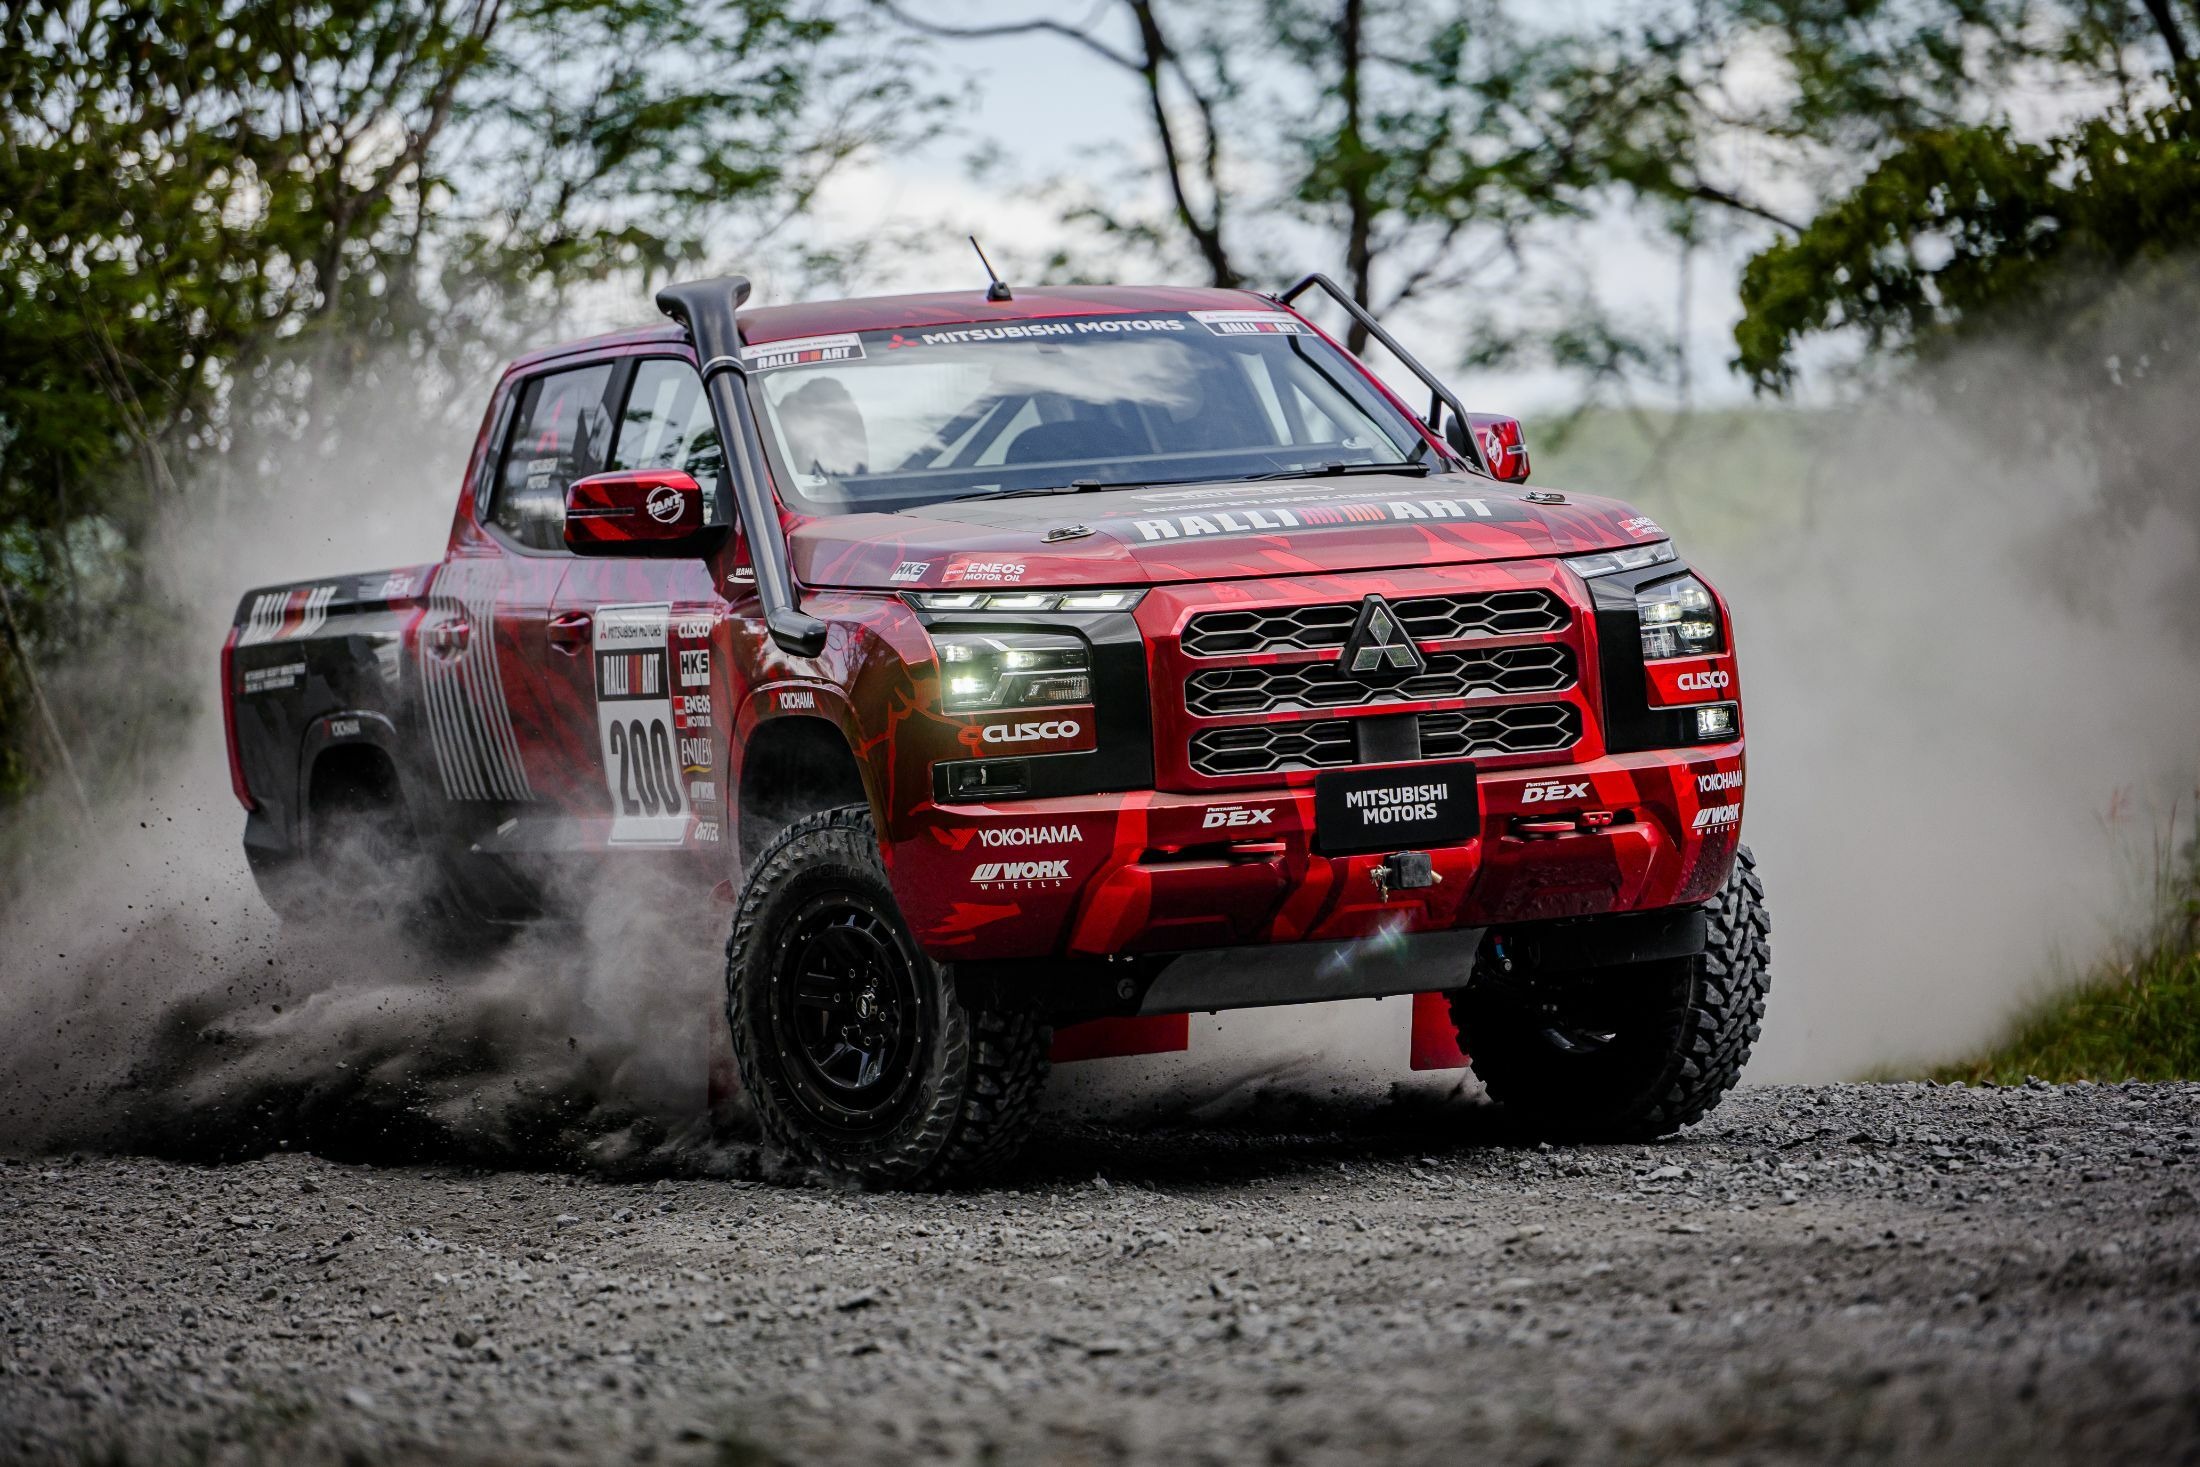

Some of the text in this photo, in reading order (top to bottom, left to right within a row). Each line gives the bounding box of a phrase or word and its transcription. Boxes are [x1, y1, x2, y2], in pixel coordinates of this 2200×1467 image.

[922, 319, 1186, 345] MITSUBISHI MOTORS
[756, 347, 851, 369] RALLI ART
[1133, 508, 1301, 541] RALLI
[1387, 499, 1493, 519] ART
[895, 561, 928, 577] HKS
[963, 573, 1021, 582] MOTOR OIL
[966, 562, 1027, 575] ENEOS
[379, 577, 415, 597] DEX
[678, 621, 711, 639] CUSCO
[603, 653, 660, 696] RALLI ART
[681, 652, 709, 676] HKS
[1678, 670, 1730, 691] CUSCO
[684, 695, 711, 714] ENEOS
[779, 691, 815, 710] YOKOHAMA
[982, 720, 1080, 743] CUSCO
[681, 737, 713, 766] ENDLESS
[610, 718, 682, 818] 200
[1346, 783, 1448, 808] MITSUBISHI
[1521, 782, 1590, 804] DEX
[1202, 807, 1276, 829] DEX
[1362, 802, 1438, 825] MOTORS
[977, 824, 1083, 848] YOKOHAMA
[1696, 823, 1736, 836] WHEELS
[1003, 859, 1070, 880] WORK
[980, 879, 1061, 890] WHEELS
